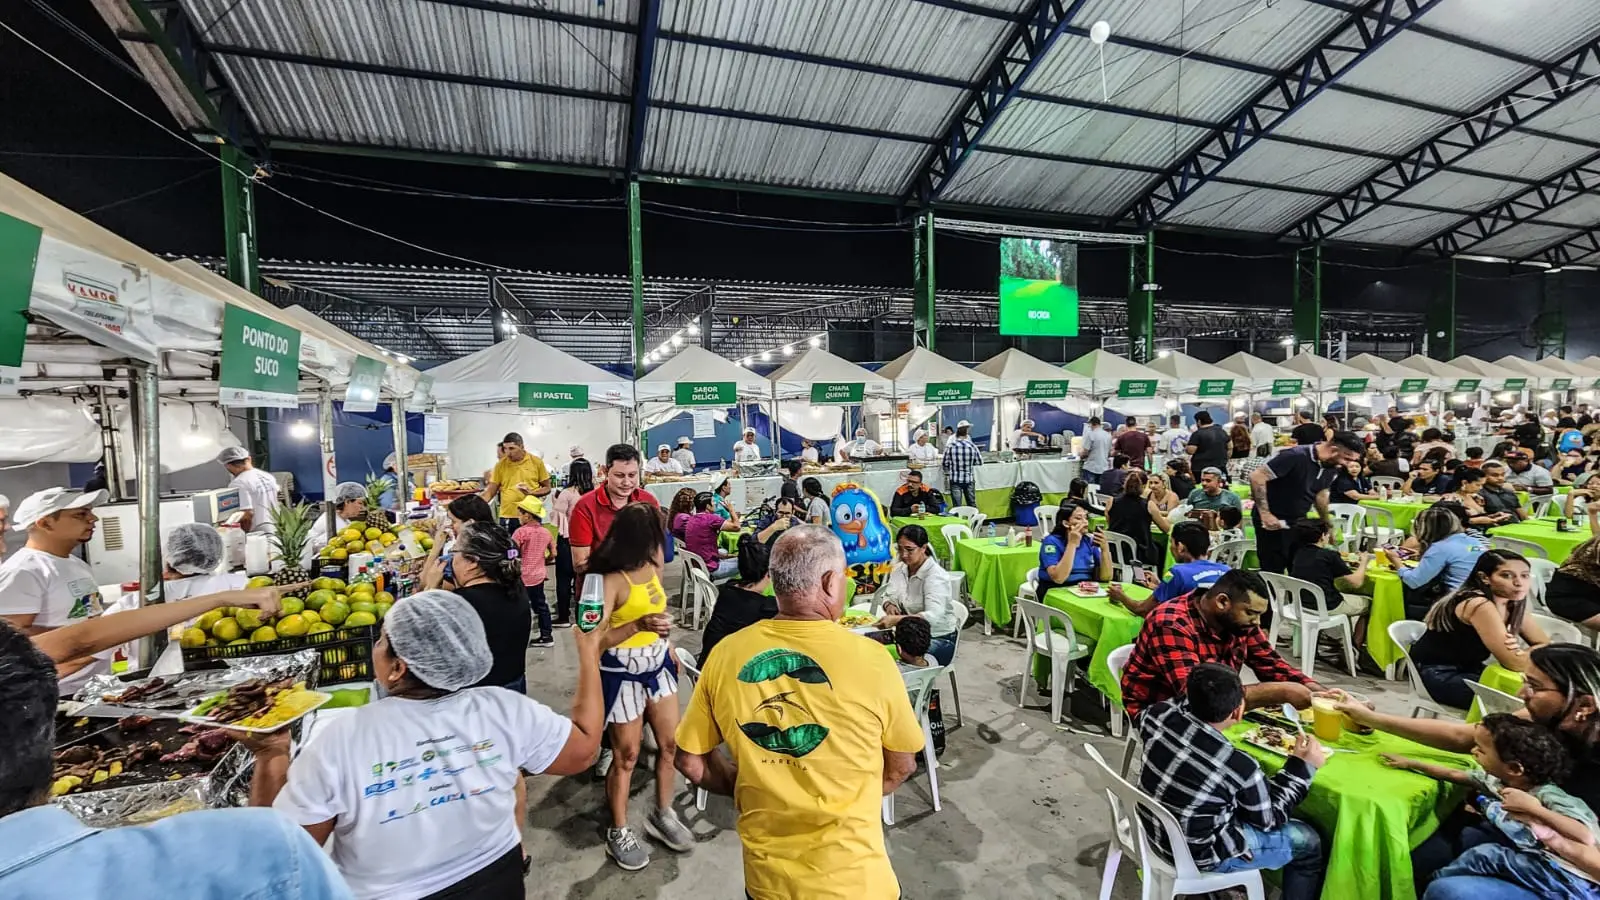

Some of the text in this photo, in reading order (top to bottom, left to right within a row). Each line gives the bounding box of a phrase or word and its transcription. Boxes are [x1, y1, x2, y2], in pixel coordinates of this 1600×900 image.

[242, 325, 289, 355] PONTO DO
[254, 356, 279, 377] SUCO
[533, 391, 574, 400] KI PASTEL
[691, 392, 720, 401] DELÍCIA
[825, 391, 850, 400] QUENTE
[430, 792, 466, 806] CAIXA
